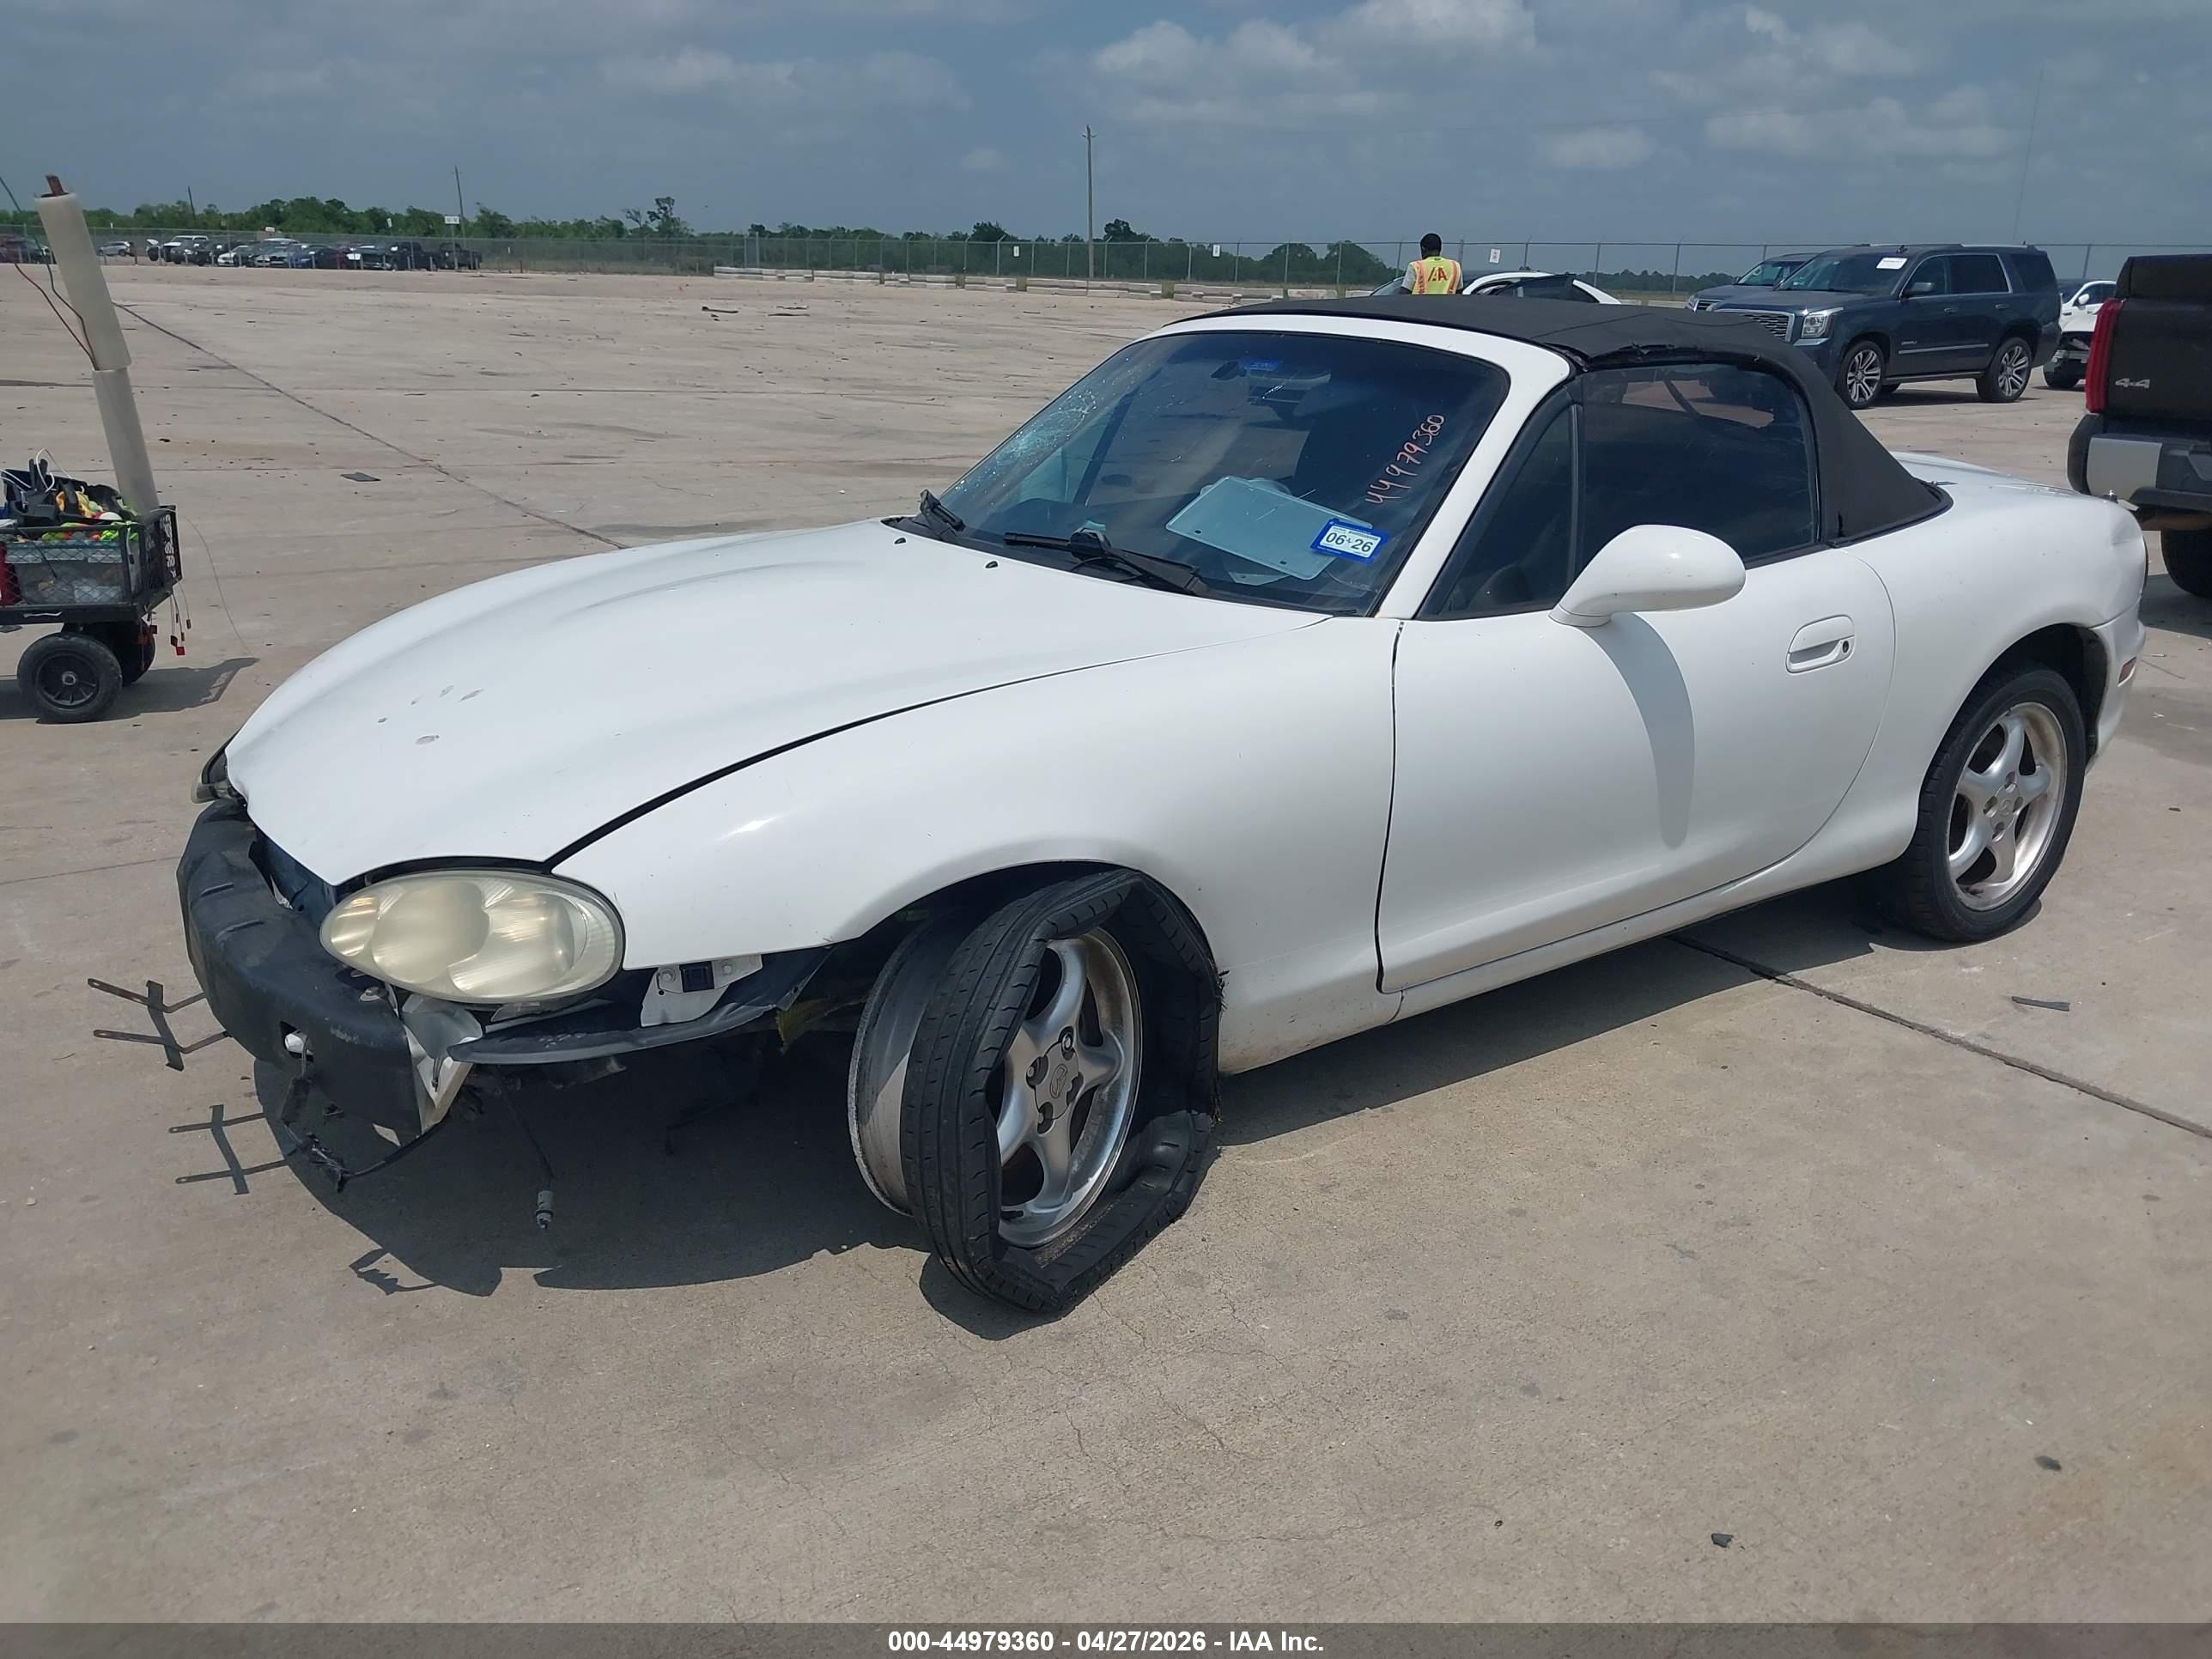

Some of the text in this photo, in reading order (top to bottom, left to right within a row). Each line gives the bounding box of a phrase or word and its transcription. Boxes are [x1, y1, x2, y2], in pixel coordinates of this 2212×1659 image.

[1364, 414, 1445, 504] 44979360
[1325, 532, 1347, 546] 06
[1350, 538, 1374, 553] 26
